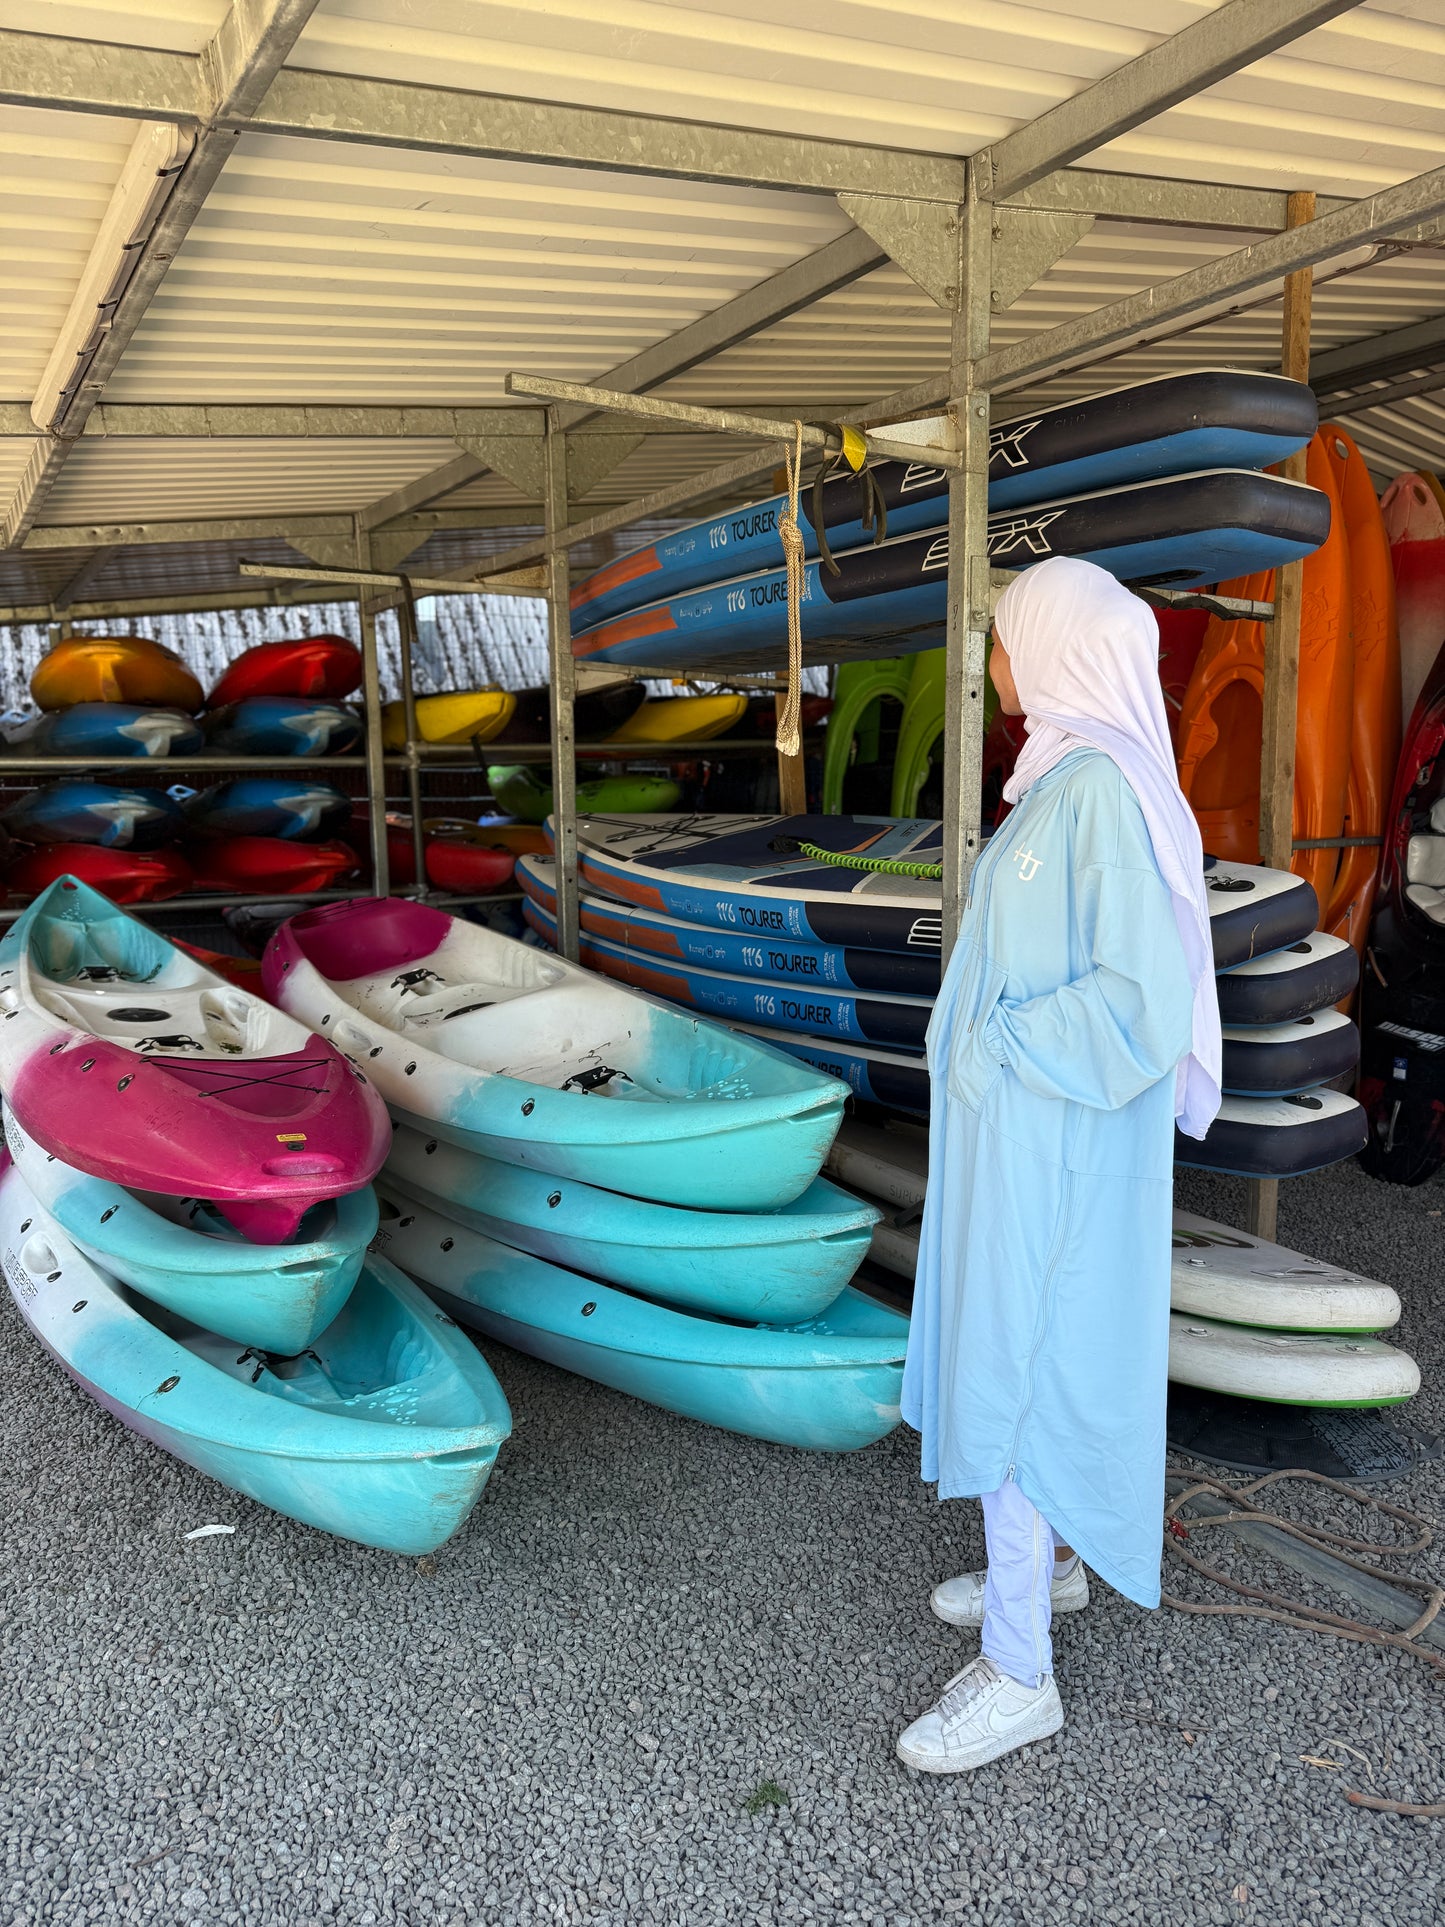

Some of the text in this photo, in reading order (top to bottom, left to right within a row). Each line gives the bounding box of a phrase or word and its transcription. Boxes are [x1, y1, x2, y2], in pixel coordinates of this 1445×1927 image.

[732, 510, 777, 542] TOURER
[750, 581, 788, 607] TOURE
[739, 907, 787, 931] TOURER
[768, 952, 820, 975] TOURER
[781, 1000, 833, 1025] TOURER
